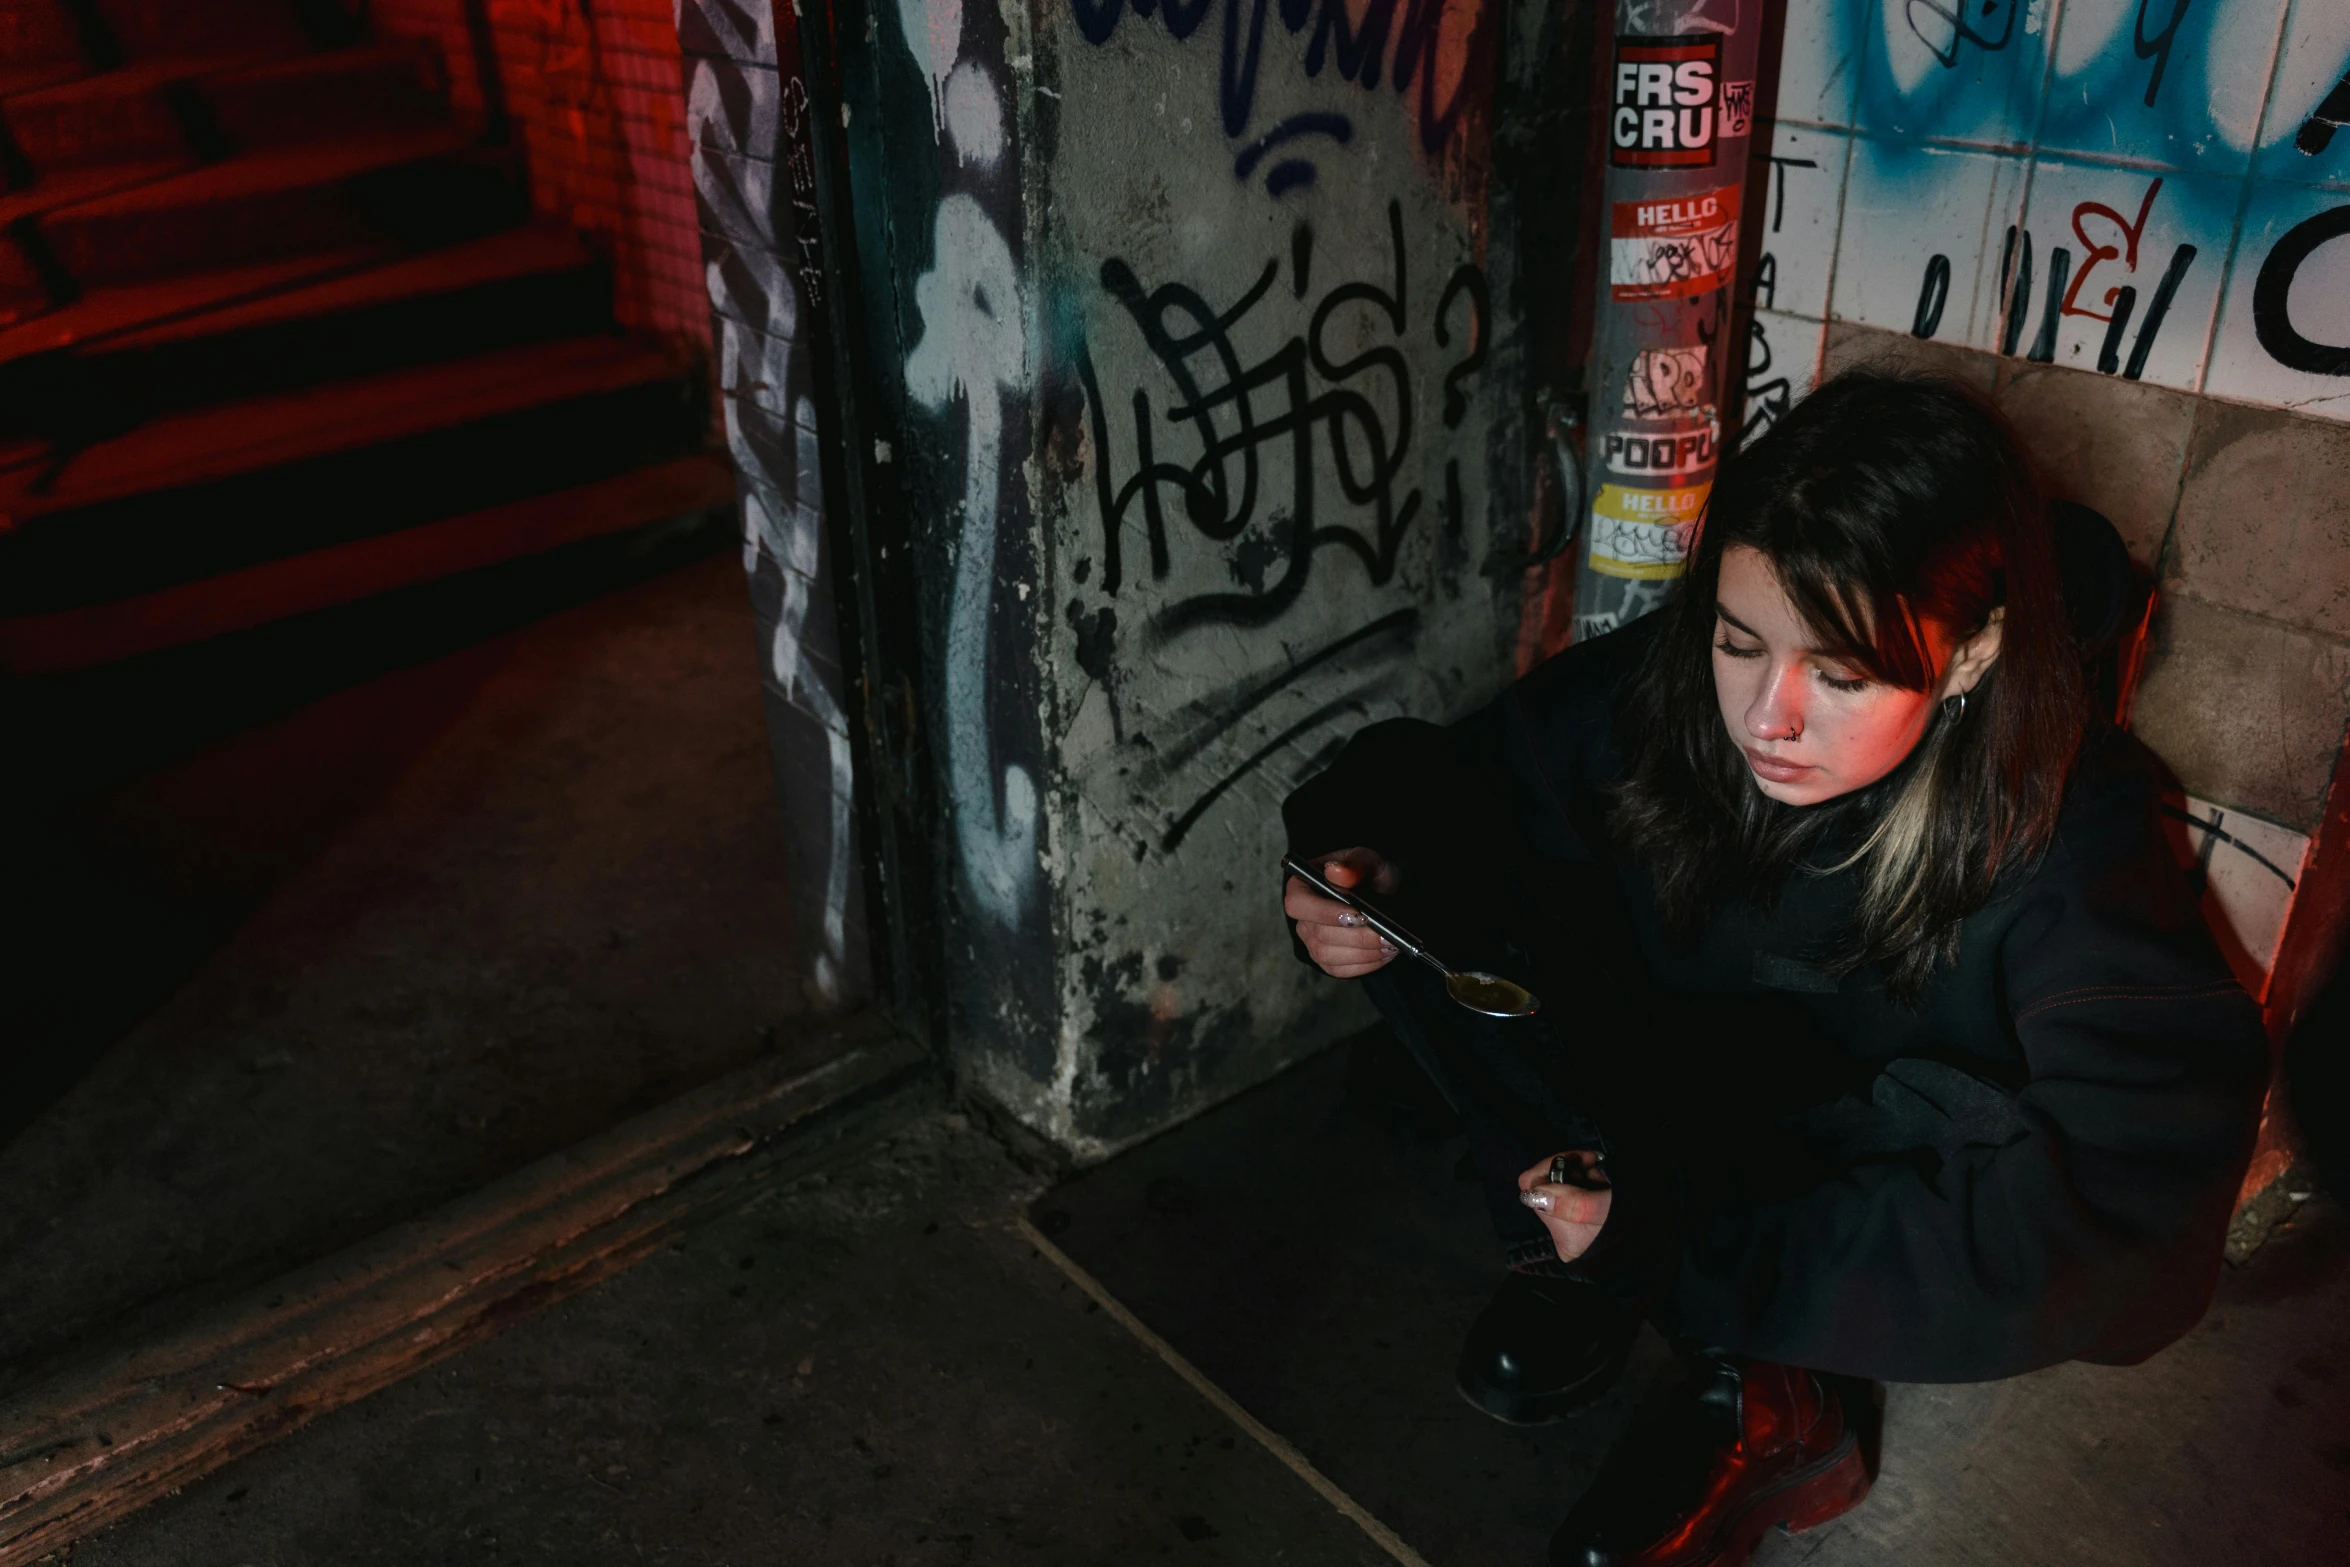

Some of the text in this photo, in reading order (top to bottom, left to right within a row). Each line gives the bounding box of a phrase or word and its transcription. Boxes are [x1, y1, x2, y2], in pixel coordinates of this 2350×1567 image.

[1616, 61, 1714, 106] FRS
[1614, 107, 1713, 148] CRU
[1637, 197, 1718, 226] HELLO
[1621, 493, 1696, 511] HELLO
